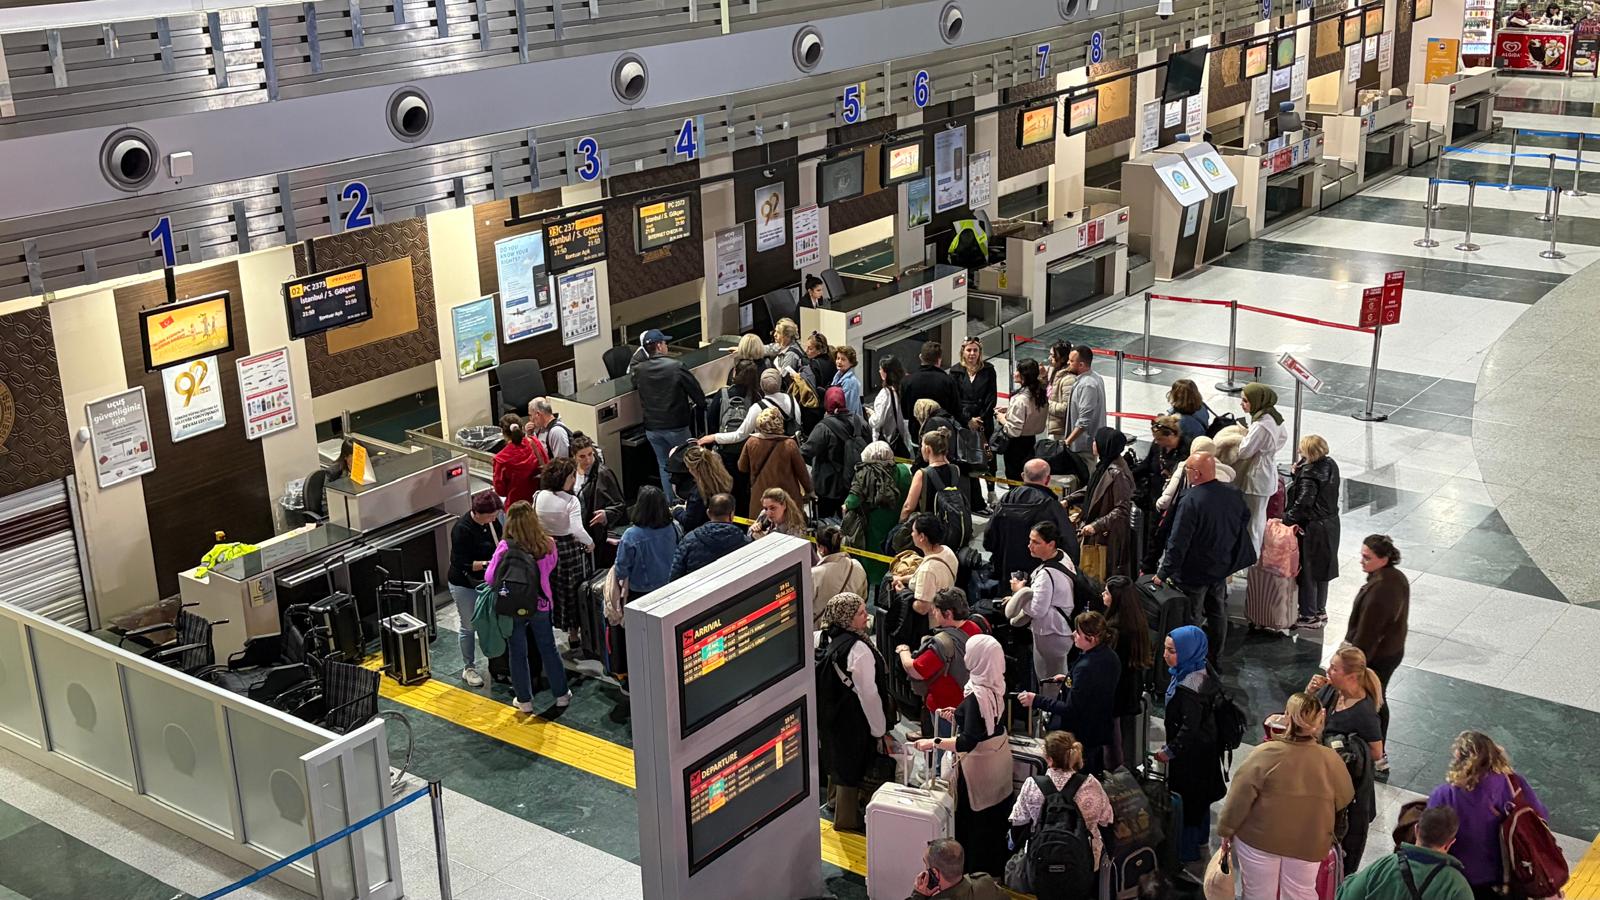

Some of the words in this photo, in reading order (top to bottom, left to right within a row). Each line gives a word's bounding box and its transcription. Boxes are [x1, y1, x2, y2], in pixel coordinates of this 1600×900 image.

[1038, 43, 1050, 78] 7
[1091, 31, 1102, 64] 8
[843, 84, 860, 124] 5
[914, 70, 929, 108] 6
[675, 118, 697, 161] 4
[577, 137, 601, 181] 3
[341, 181, 373, 230] 2
[149, 215, 177, 268] 1
[500, 251, 515, 259] KNOW
[516, 248, 529, 256] YOUR
[549, 234, 571, 247] stanbul
[291, 287, 301, 296] 02
[312, 281, 326, 290] 2373
[300, 292, 323, 304] İstanbul
[334, 285, 356, 296] Gökçen
[175, 360, 208, 408] 92
[107, 398, 126, 409] uçuş
[111, 417, 126, 427] için
[694, 619, 722, 639] ARRIVAL
[701, 750, 738, 779] DEPARTURE
